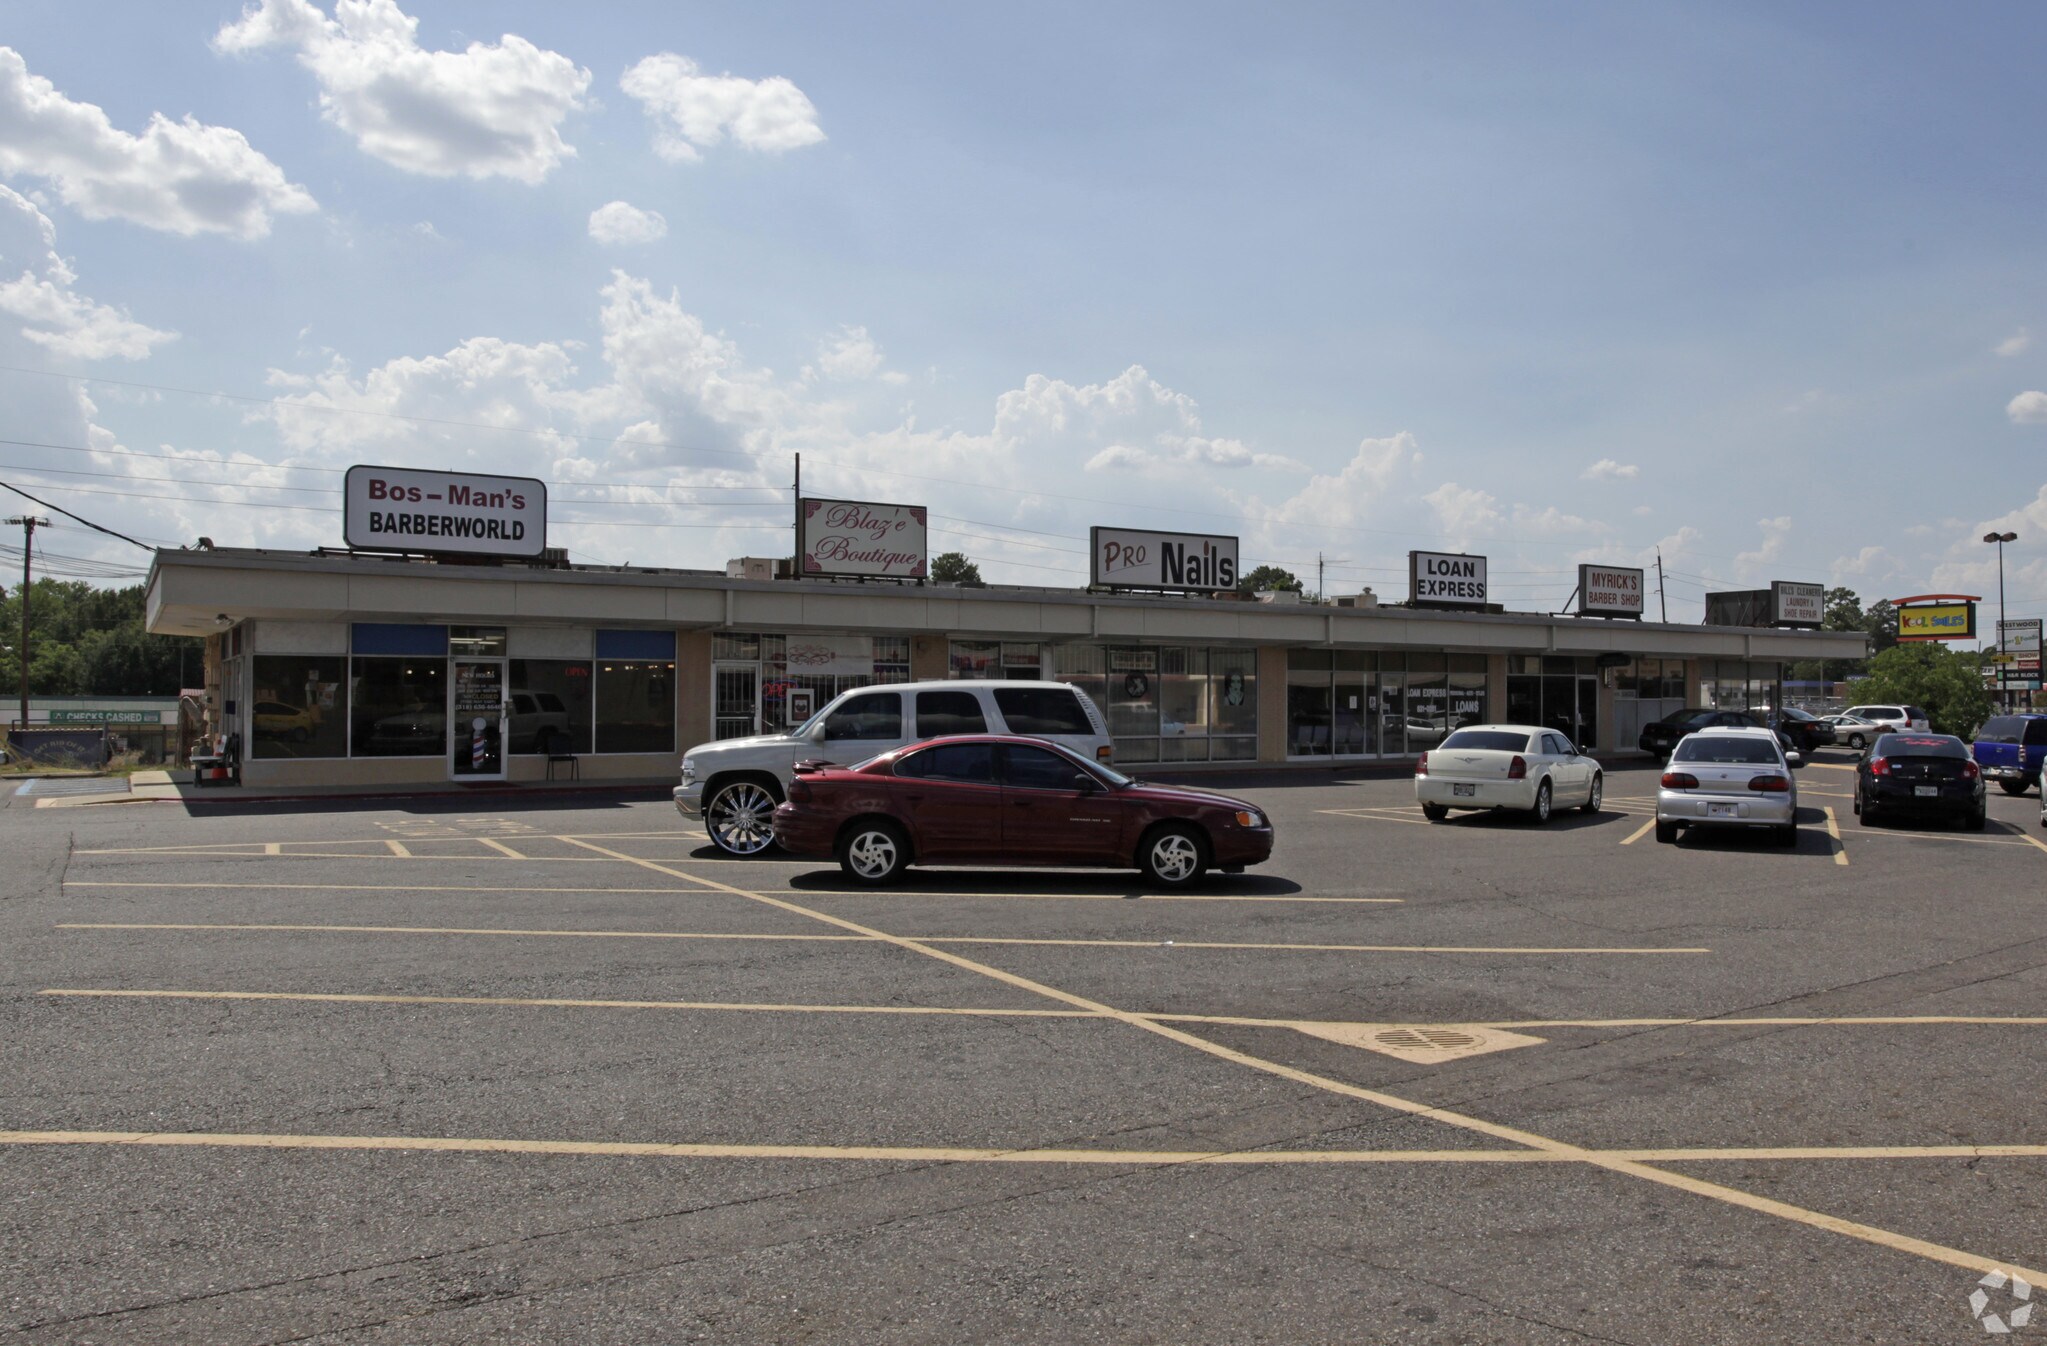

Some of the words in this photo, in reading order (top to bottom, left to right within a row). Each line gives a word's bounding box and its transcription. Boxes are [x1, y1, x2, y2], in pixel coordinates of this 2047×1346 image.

[370, 512, 525, 541] BARBERWORLD
[814, 536, 918, 571] Boutique
[1161, 540, 1234, 587] Nails
[1428, 559, 1475, 578] LOAN
[1592, 572, 1637, 590] MYRICK'S
[1417, 579, 1485, 598] EXPRESS
[1796, 586, 1821, 597] CLEANERS
[1588, 591, 1617, 605] BARBER
[1620, 593, 1640, 606] SHOP
[1786, 597, 1809, 607] LAUNDRY
[1783, 608, 1797, 618] SHOE
[1798, 609, 1818, 619] REPAIR
[1930, 615, 1965, 628] SMILES
[1407, 688, 1421, 697] LOAN
[1422, 688, 1447, 697] EXPRESS
[1456, 700, 1479, 713] LOANS
[66, 712, 103, 722] CHECKS
[105, 712, 142, 722] CASHED
